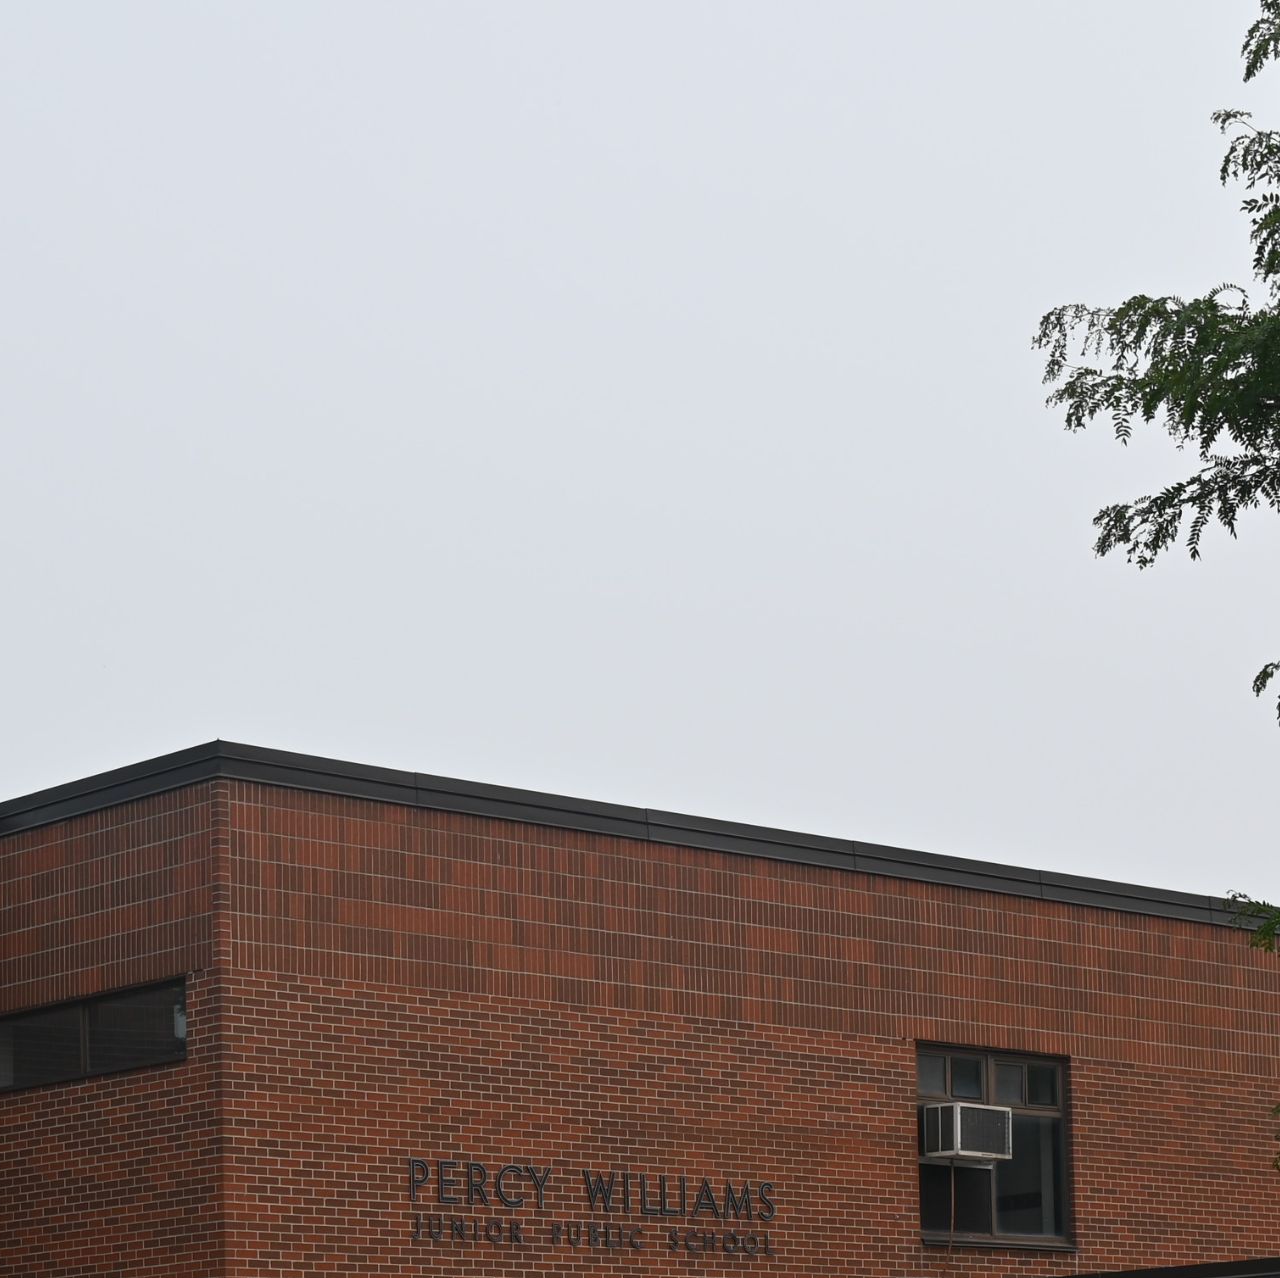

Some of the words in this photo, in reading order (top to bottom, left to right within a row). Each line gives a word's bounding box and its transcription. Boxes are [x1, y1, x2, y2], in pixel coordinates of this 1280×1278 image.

[409, 1157, 551, 1210] PERCY
[582, 1168, 776, 1221] WILLIAMS
[412, 1215, 524, 1243] JUNIOR
[552, 1222, 643, 1249] PUBLIC
[669, 1228, 775, 1255] SCHOOL
